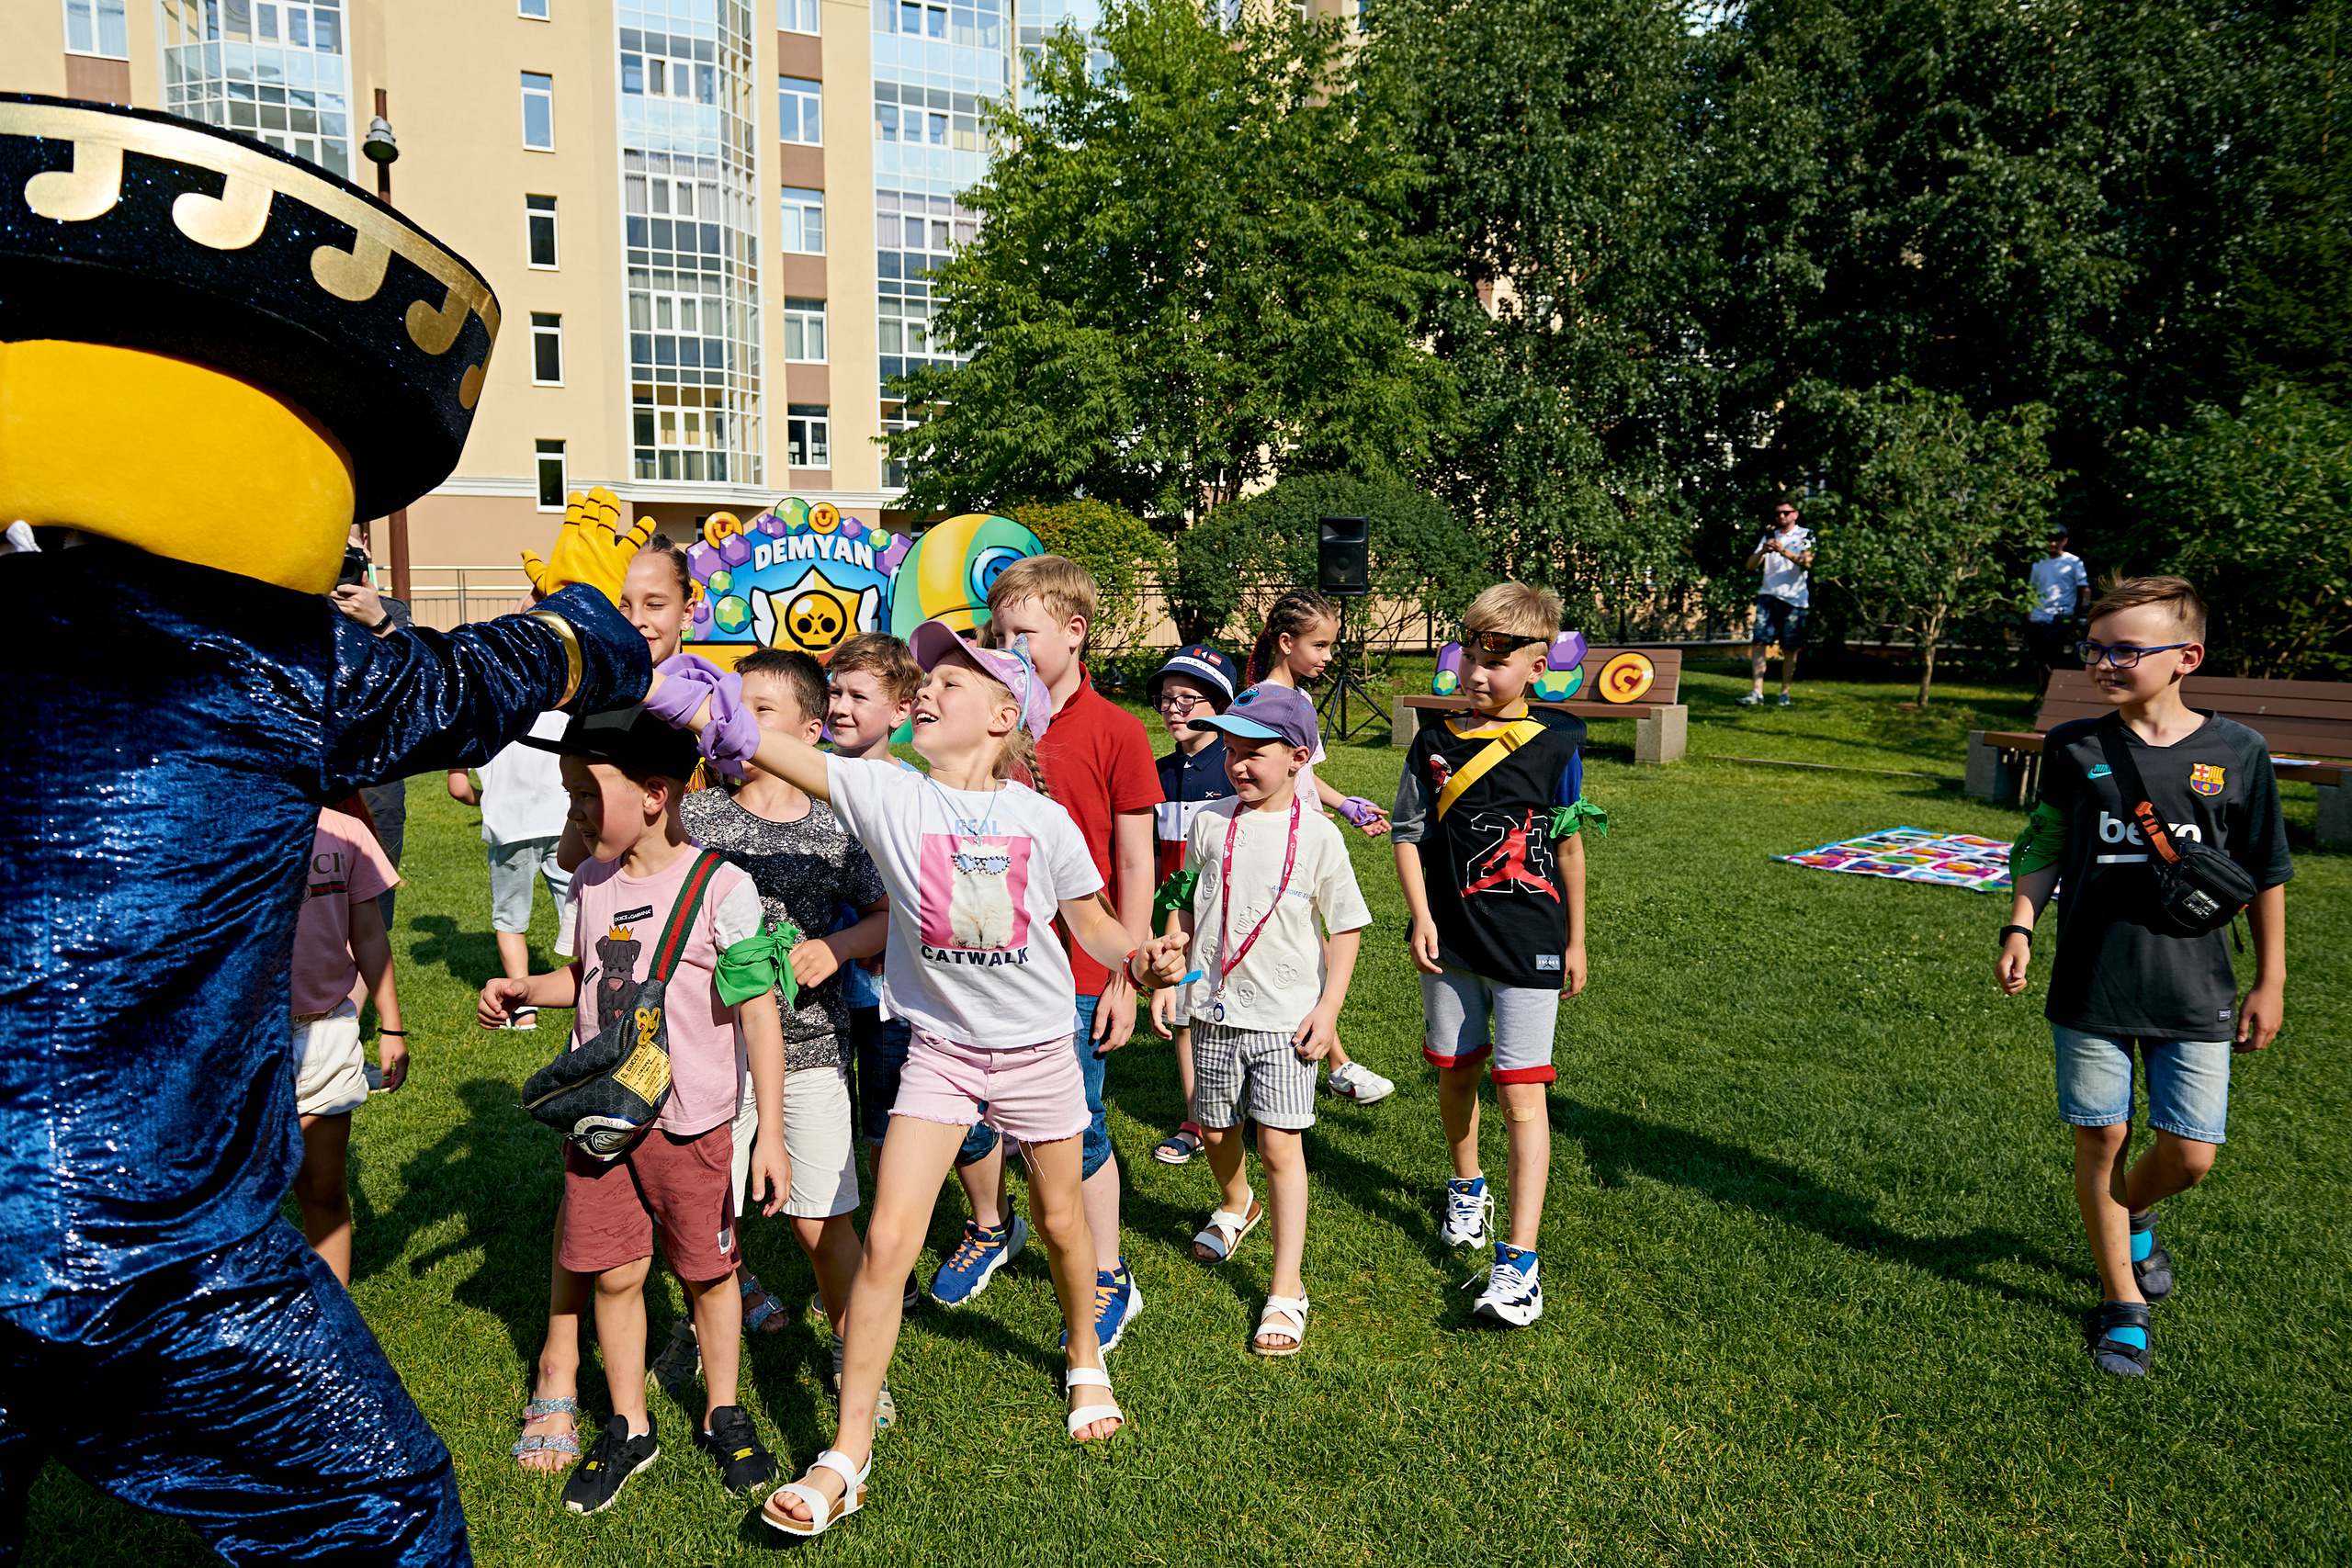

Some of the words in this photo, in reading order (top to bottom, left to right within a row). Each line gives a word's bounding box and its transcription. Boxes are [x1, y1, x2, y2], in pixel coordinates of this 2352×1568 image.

[754, 534, 874, 572] DEMYAN
[955, 818, 1002, 836] REAL
[2098, 810, 2202, 846] beo
[921, 945, 1029, 967] CATWALK
[626, 1054, 640, 1072] GUCCI
